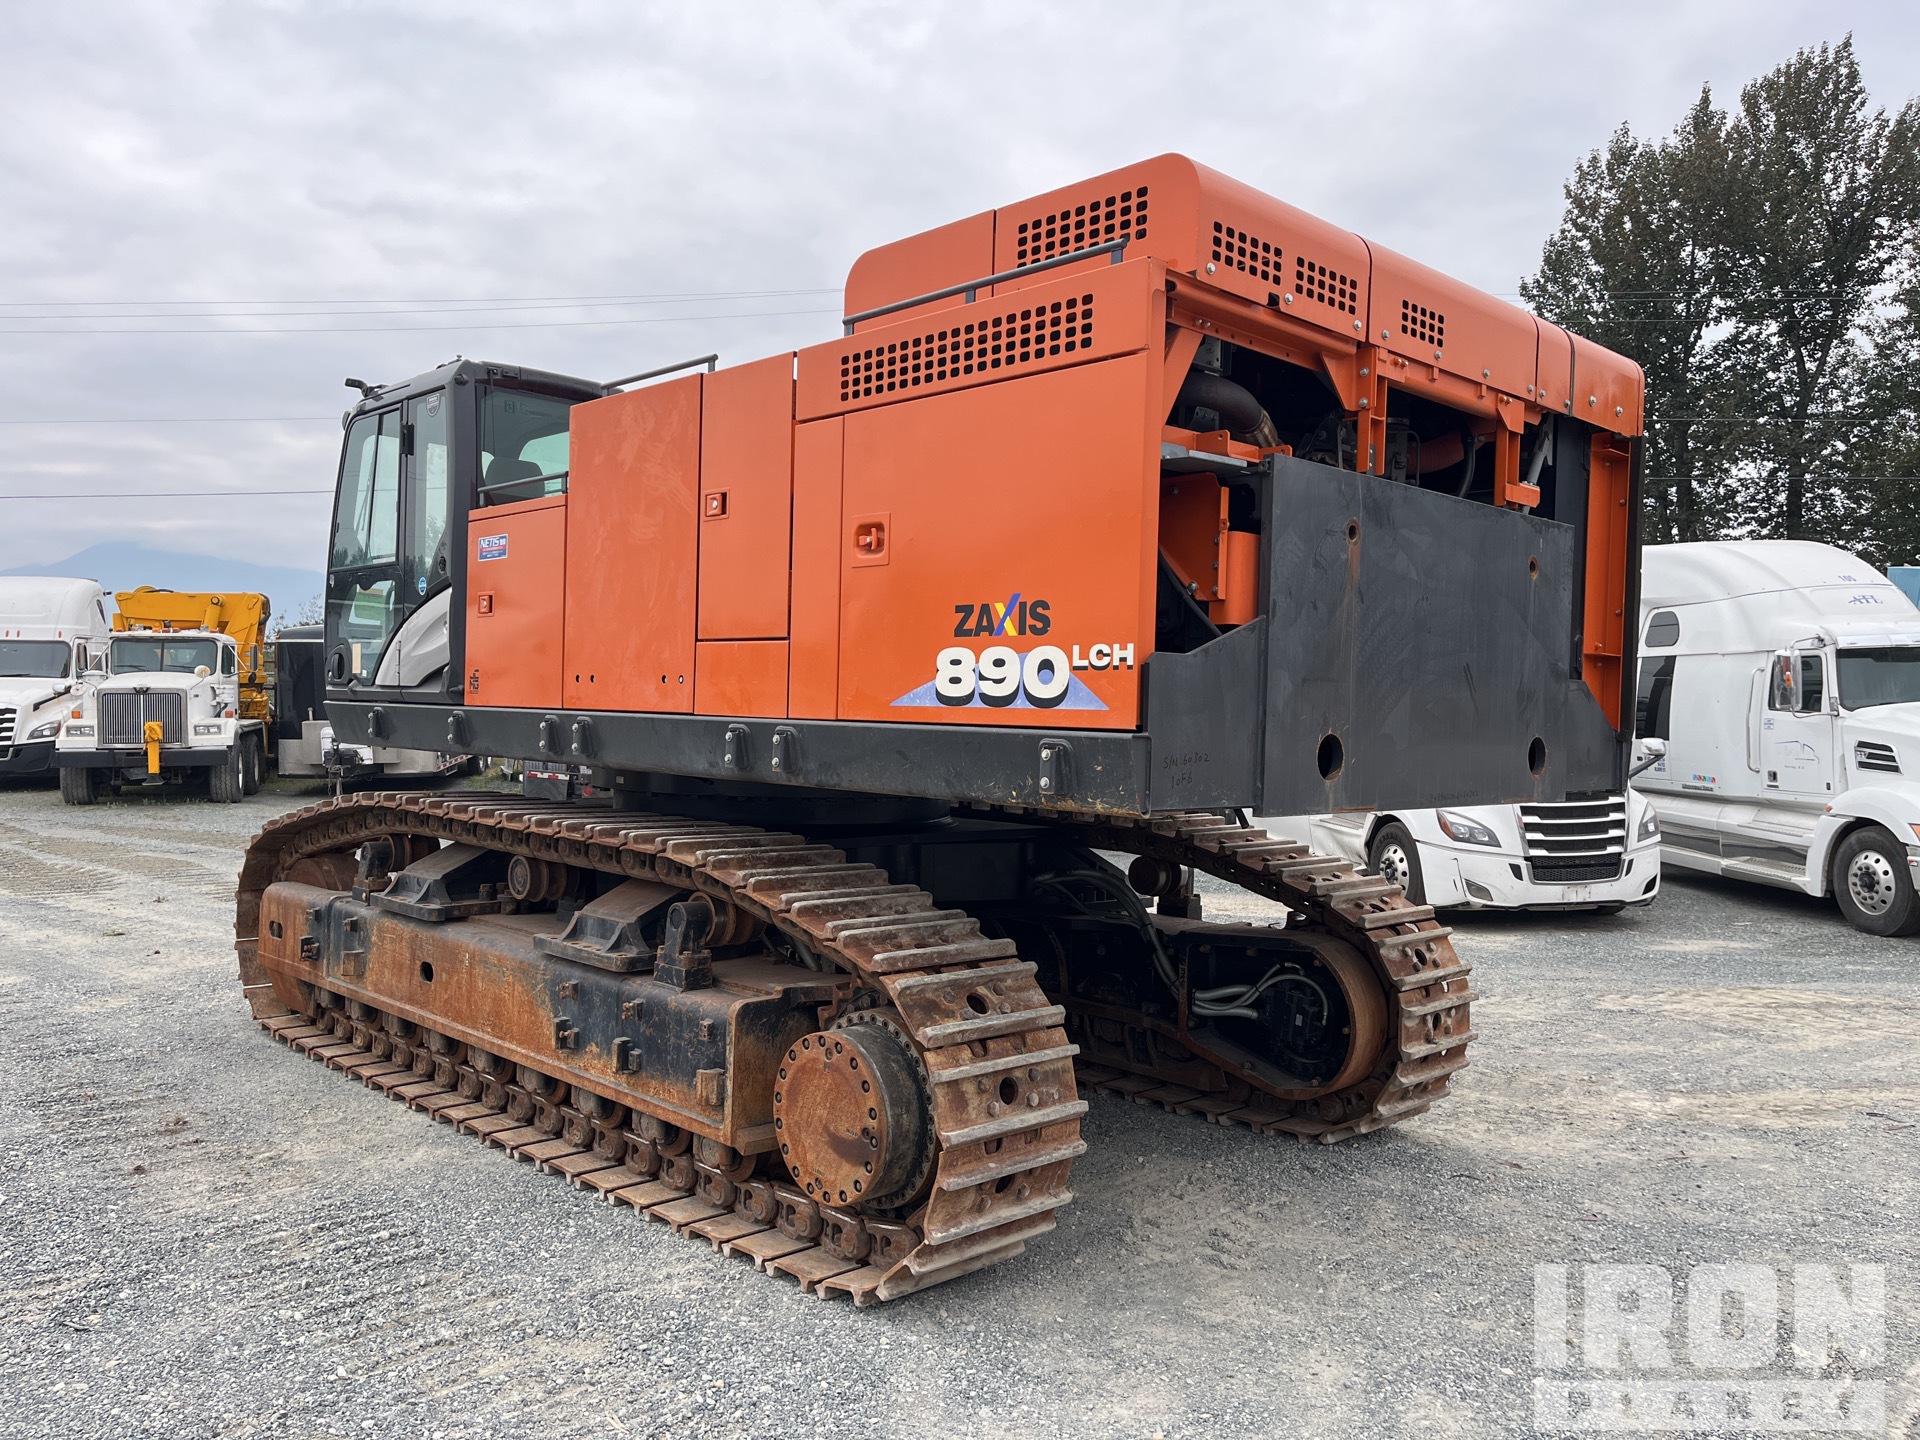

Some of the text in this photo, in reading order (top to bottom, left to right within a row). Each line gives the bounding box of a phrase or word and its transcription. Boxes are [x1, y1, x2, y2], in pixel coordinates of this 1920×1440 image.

[954, 593, 1051, 637] ZAXIS
[935, 643, 1134, 708] 890 LCH
